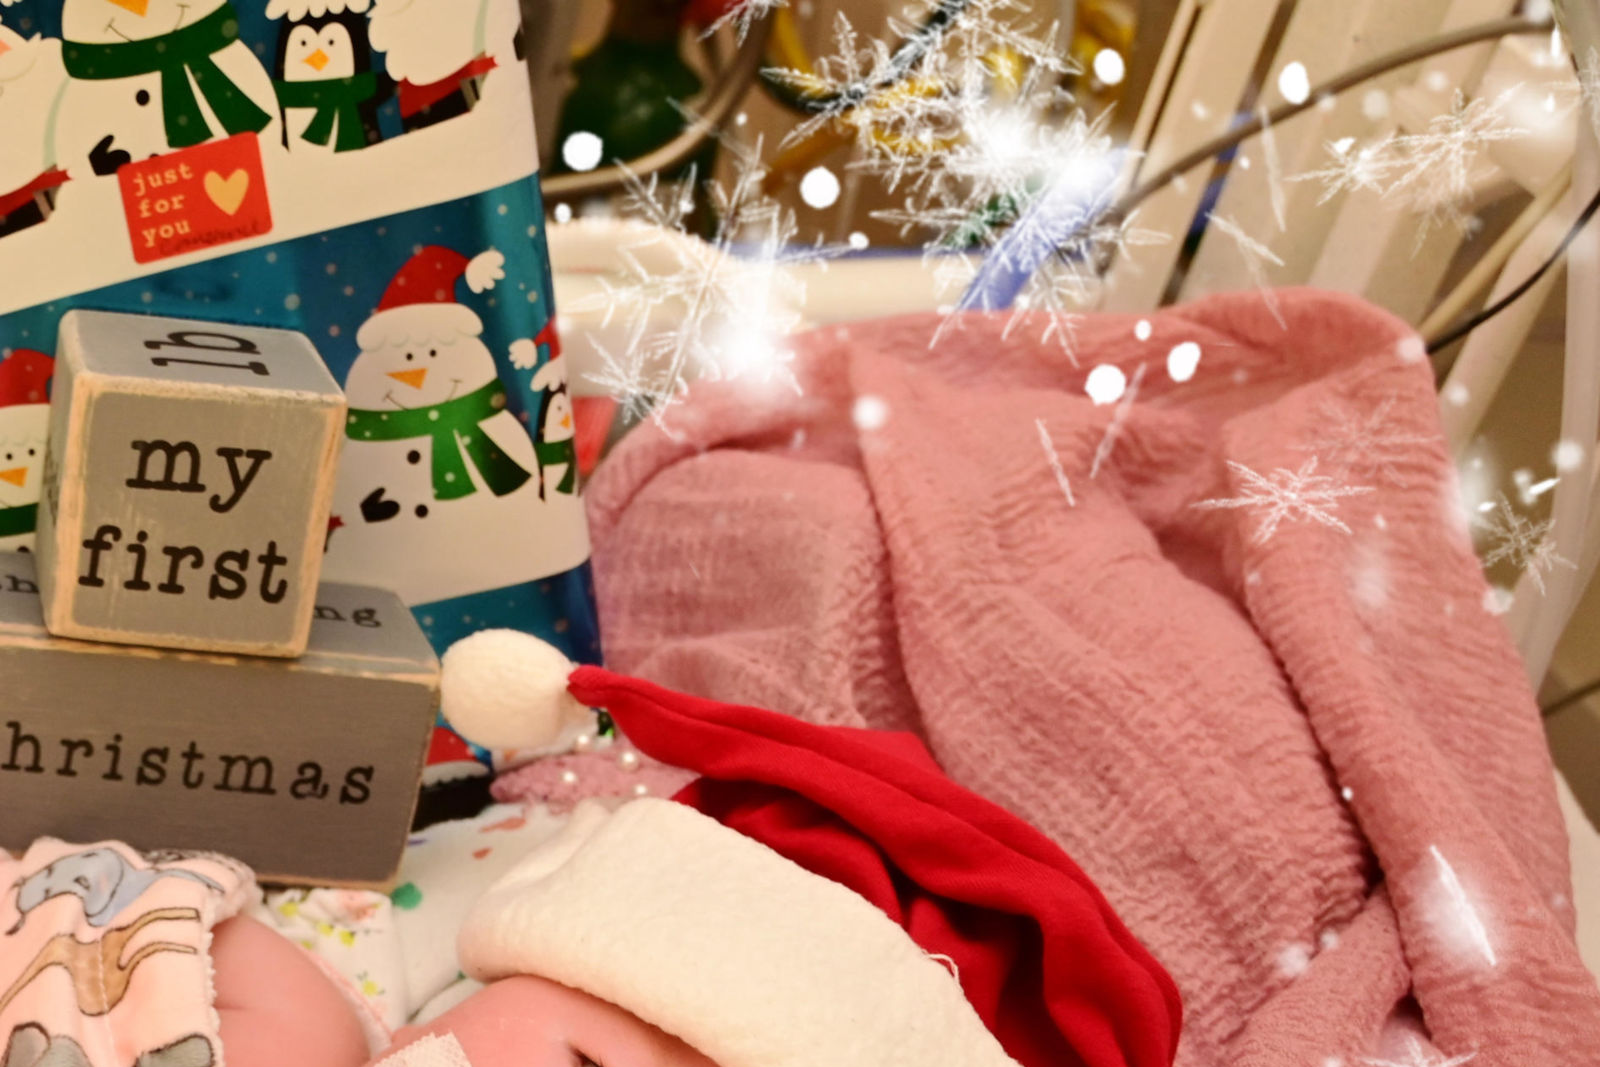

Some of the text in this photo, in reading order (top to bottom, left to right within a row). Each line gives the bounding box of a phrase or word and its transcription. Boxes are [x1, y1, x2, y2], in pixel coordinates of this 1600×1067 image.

[133, 163, 193, 196] just
[139, 194, 185, 218] for
[142, 220, 191, 248] you
[125, 439, 272, 513] my
[77, 524, 288, 604] first
